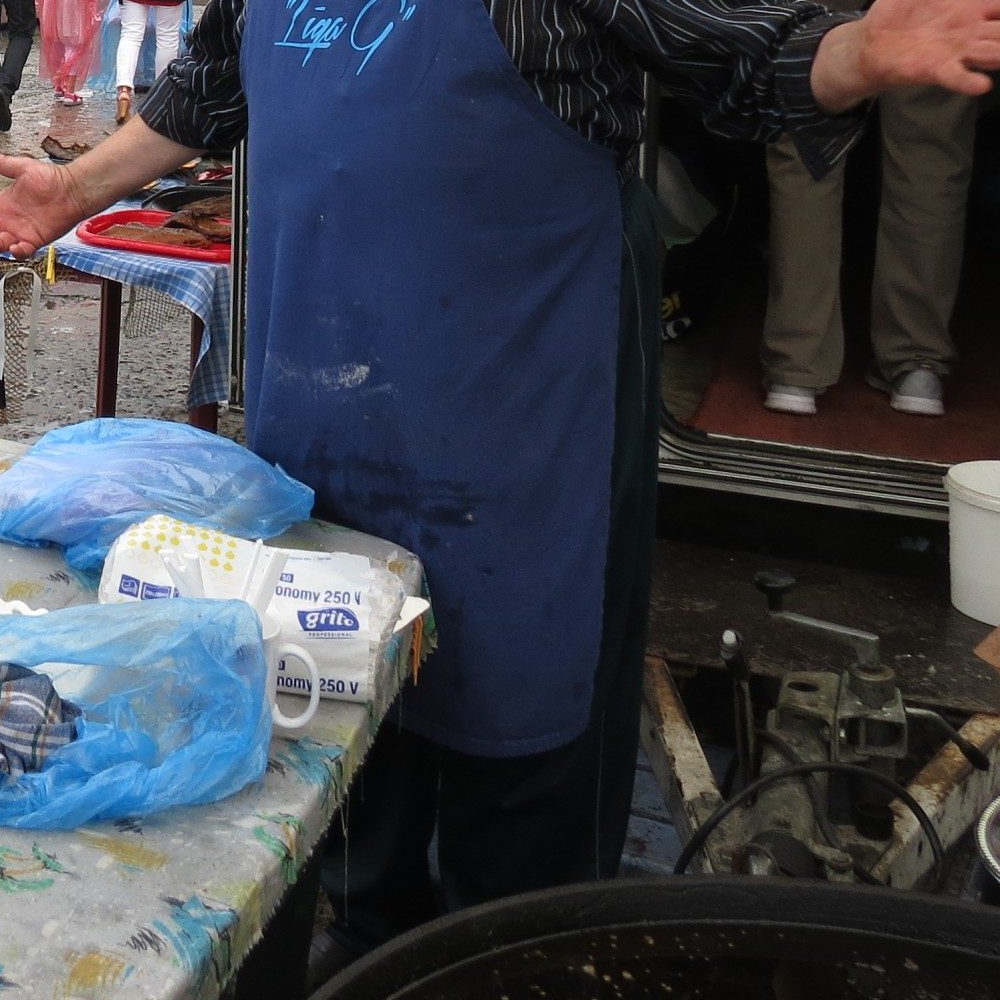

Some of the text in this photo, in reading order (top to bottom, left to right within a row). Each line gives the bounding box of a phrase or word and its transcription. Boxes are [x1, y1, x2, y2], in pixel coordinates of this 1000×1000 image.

[275, 586, 320, 603] onomy
[324, 590, 351, 605] 250
[319, 678, 345, 694] 250
[349, 681, 359, 695] V
